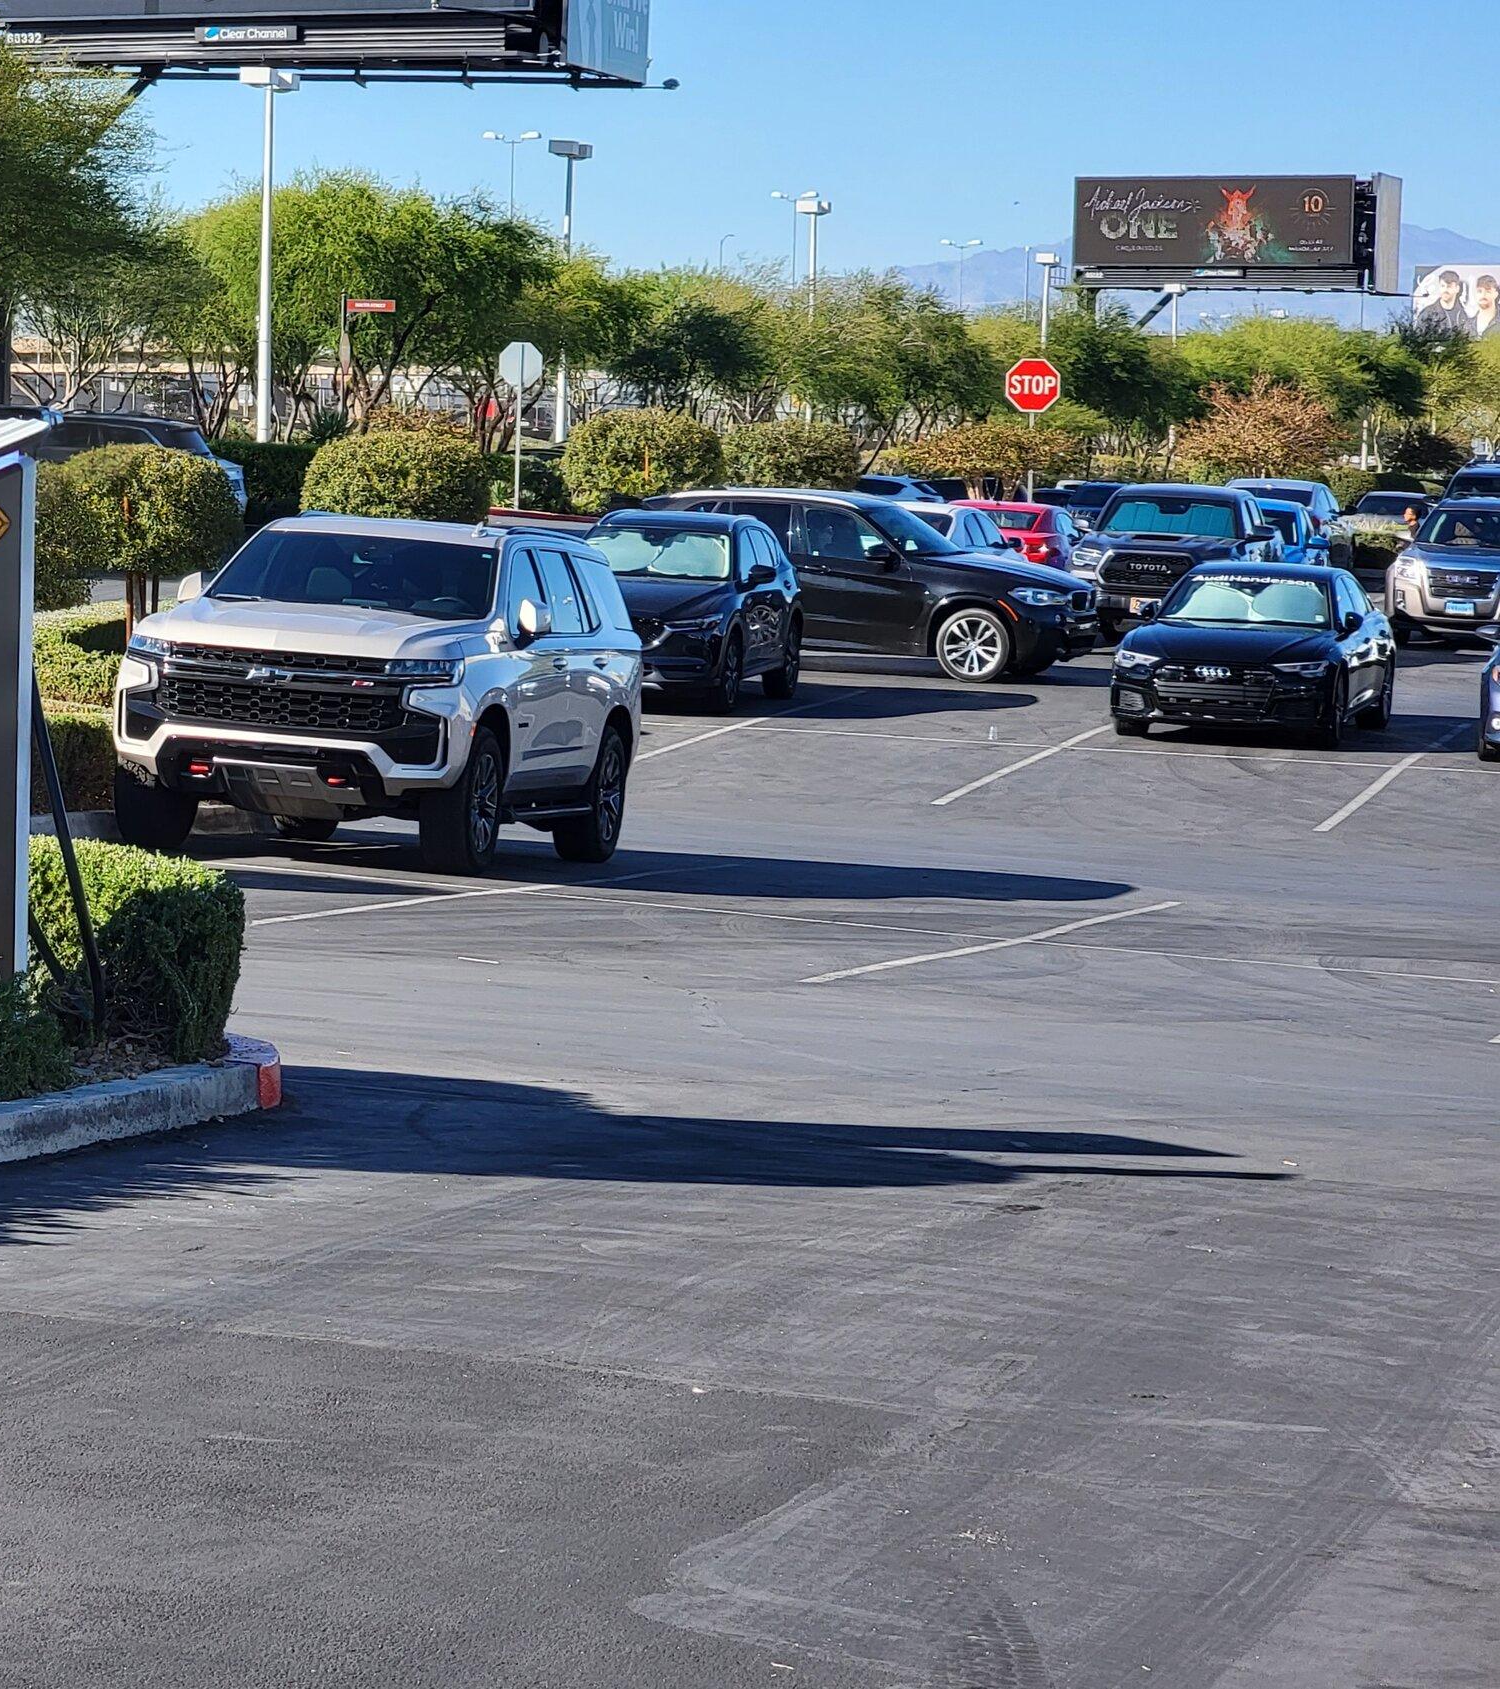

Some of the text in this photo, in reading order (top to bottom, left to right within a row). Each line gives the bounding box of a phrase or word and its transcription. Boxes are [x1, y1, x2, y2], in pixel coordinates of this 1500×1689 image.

[220, 28, 288, 39] Clear Channel
[1303, 196, 1323, 212] 10
[1100, 213, 1178, 240] ONE
[1010, 375, 1056, 395] STOP
[1130, 563, 1168, 571] TOYOTA
[1229, 575, 1316, 586] Henderson
